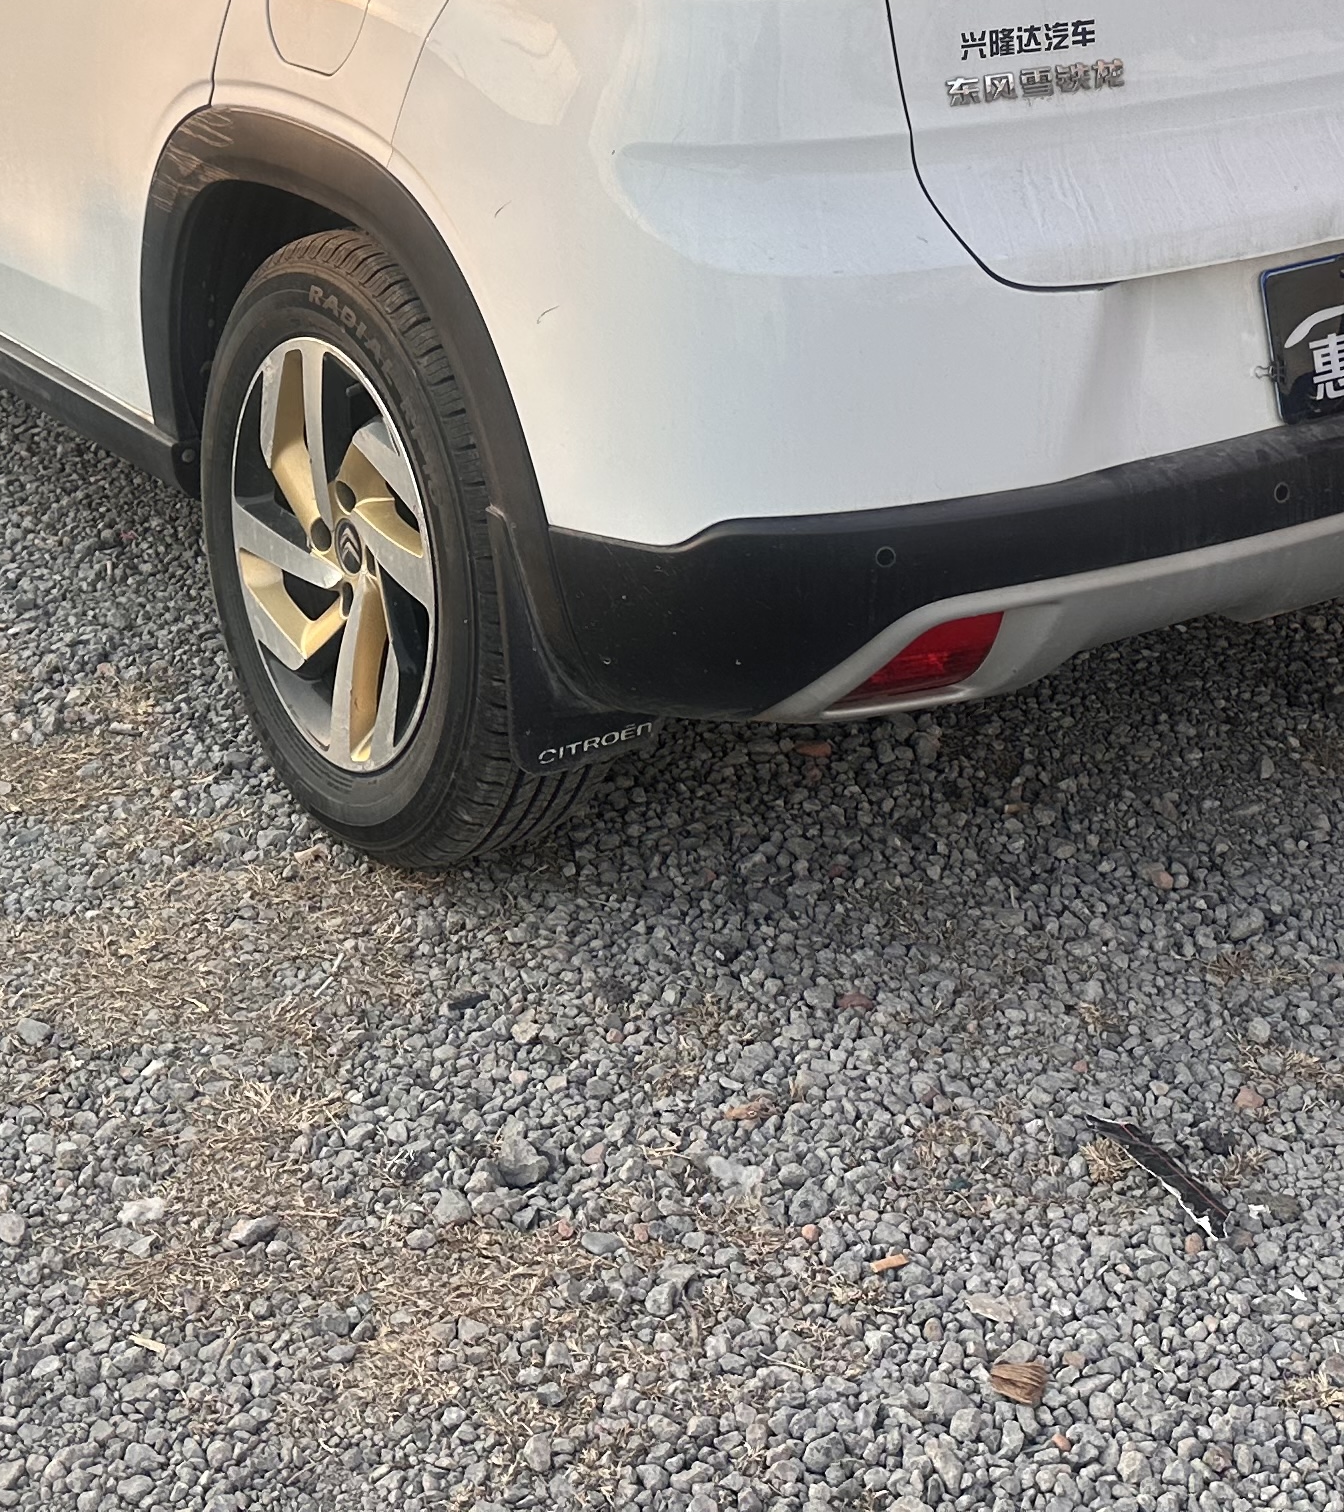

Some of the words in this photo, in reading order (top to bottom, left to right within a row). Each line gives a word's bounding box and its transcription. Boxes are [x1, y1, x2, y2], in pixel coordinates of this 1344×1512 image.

[960, 19, 1096, 61] 兴隆达汽车
[308, 284, 394, 386] RADIAL
